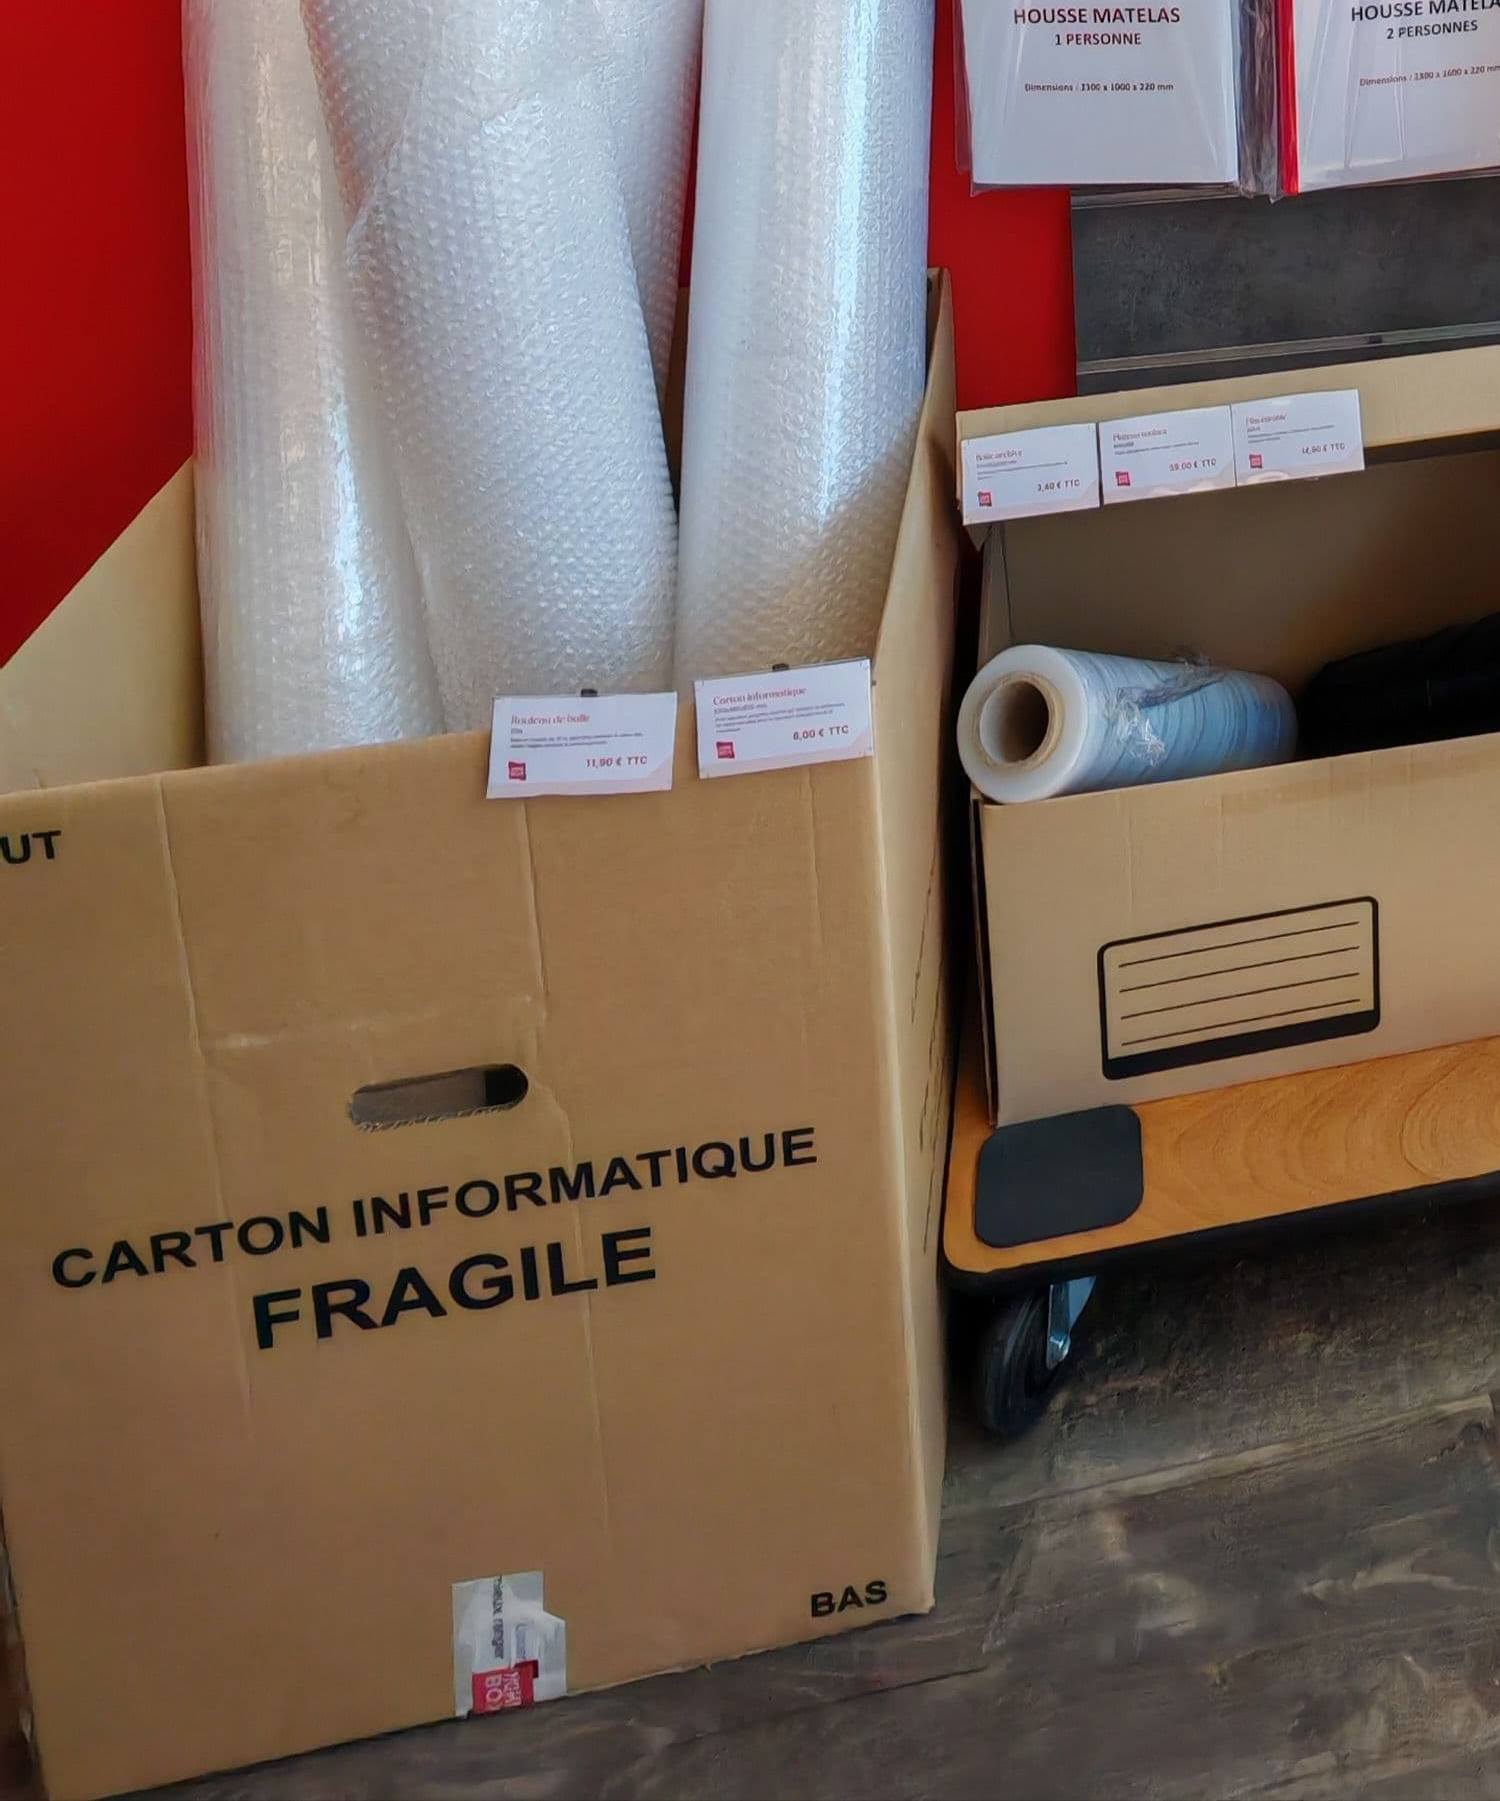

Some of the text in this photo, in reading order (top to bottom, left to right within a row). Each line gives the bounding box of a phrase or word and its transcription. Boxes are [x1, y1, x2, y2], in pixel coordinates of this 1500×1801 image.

[1014, 7, 1180, 24] HOUSSE MATELAS
[1351, 1, 1423, 21] HOUSSE
[1055, 33, 1141, 45] 1 PERSONNE
[1386, 20, 1478, 39] 2 PERSONNES
[1360, 74, 1407, 86] Dimensions
[829, 725, 849, 736] TTC
[627, 756, 648, 765] TTC
[0, 830, 62, 864] UT
[51, 1127, 817, 1289] CARTON INFORMATIQUE
[253, 1227, 656, 1350] FRAGILE
[810, 1579, 888, 1617] BAS
